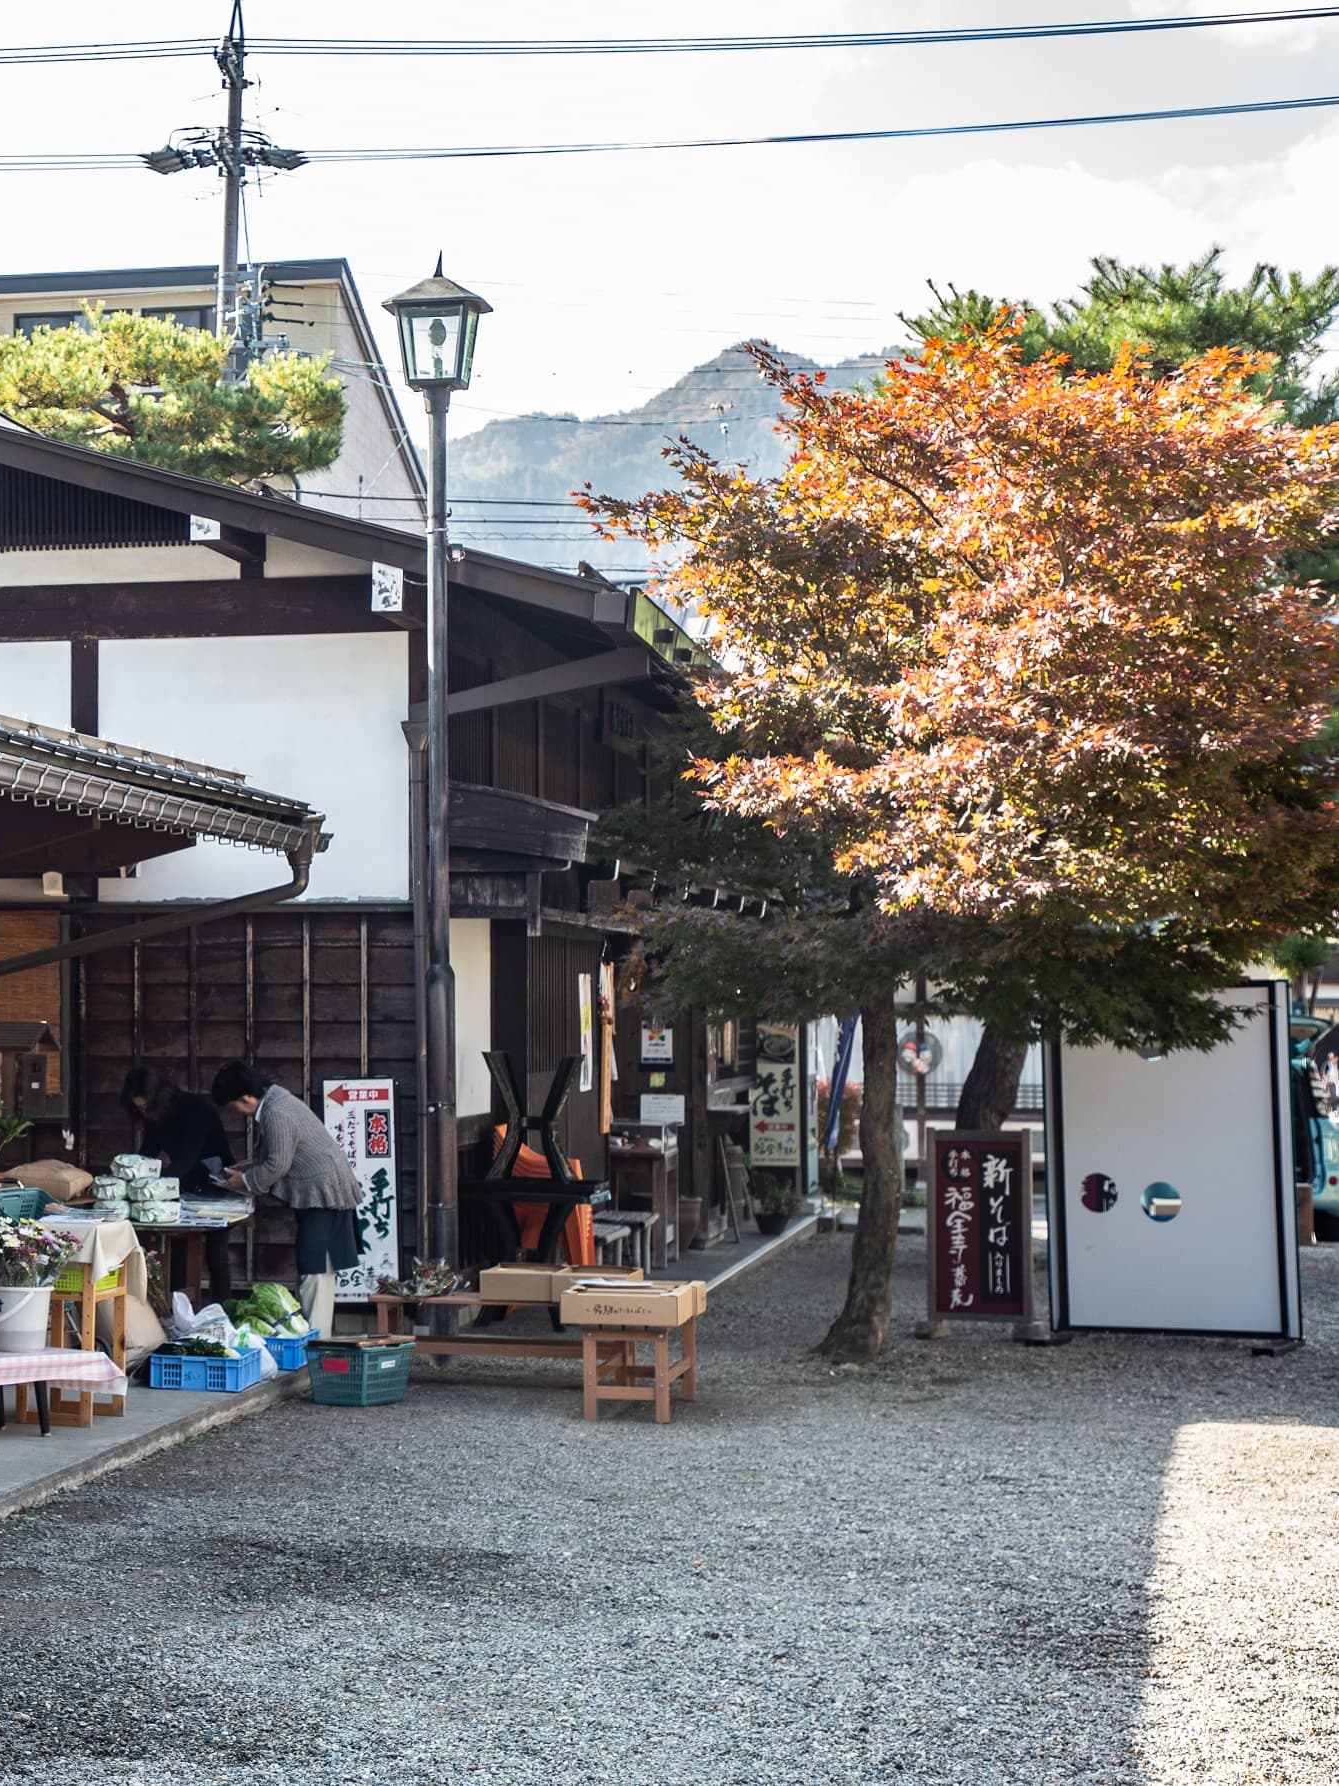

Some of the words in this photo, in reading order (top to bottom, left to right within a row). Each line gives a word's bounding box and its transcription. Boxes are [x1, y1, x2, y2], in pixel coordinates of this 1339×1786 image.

[368, 1113, 389, 1154] 本格
[369, 1167, 396, 1241] 手打ち
[982, 1153, 1015, 1247] 新そば
